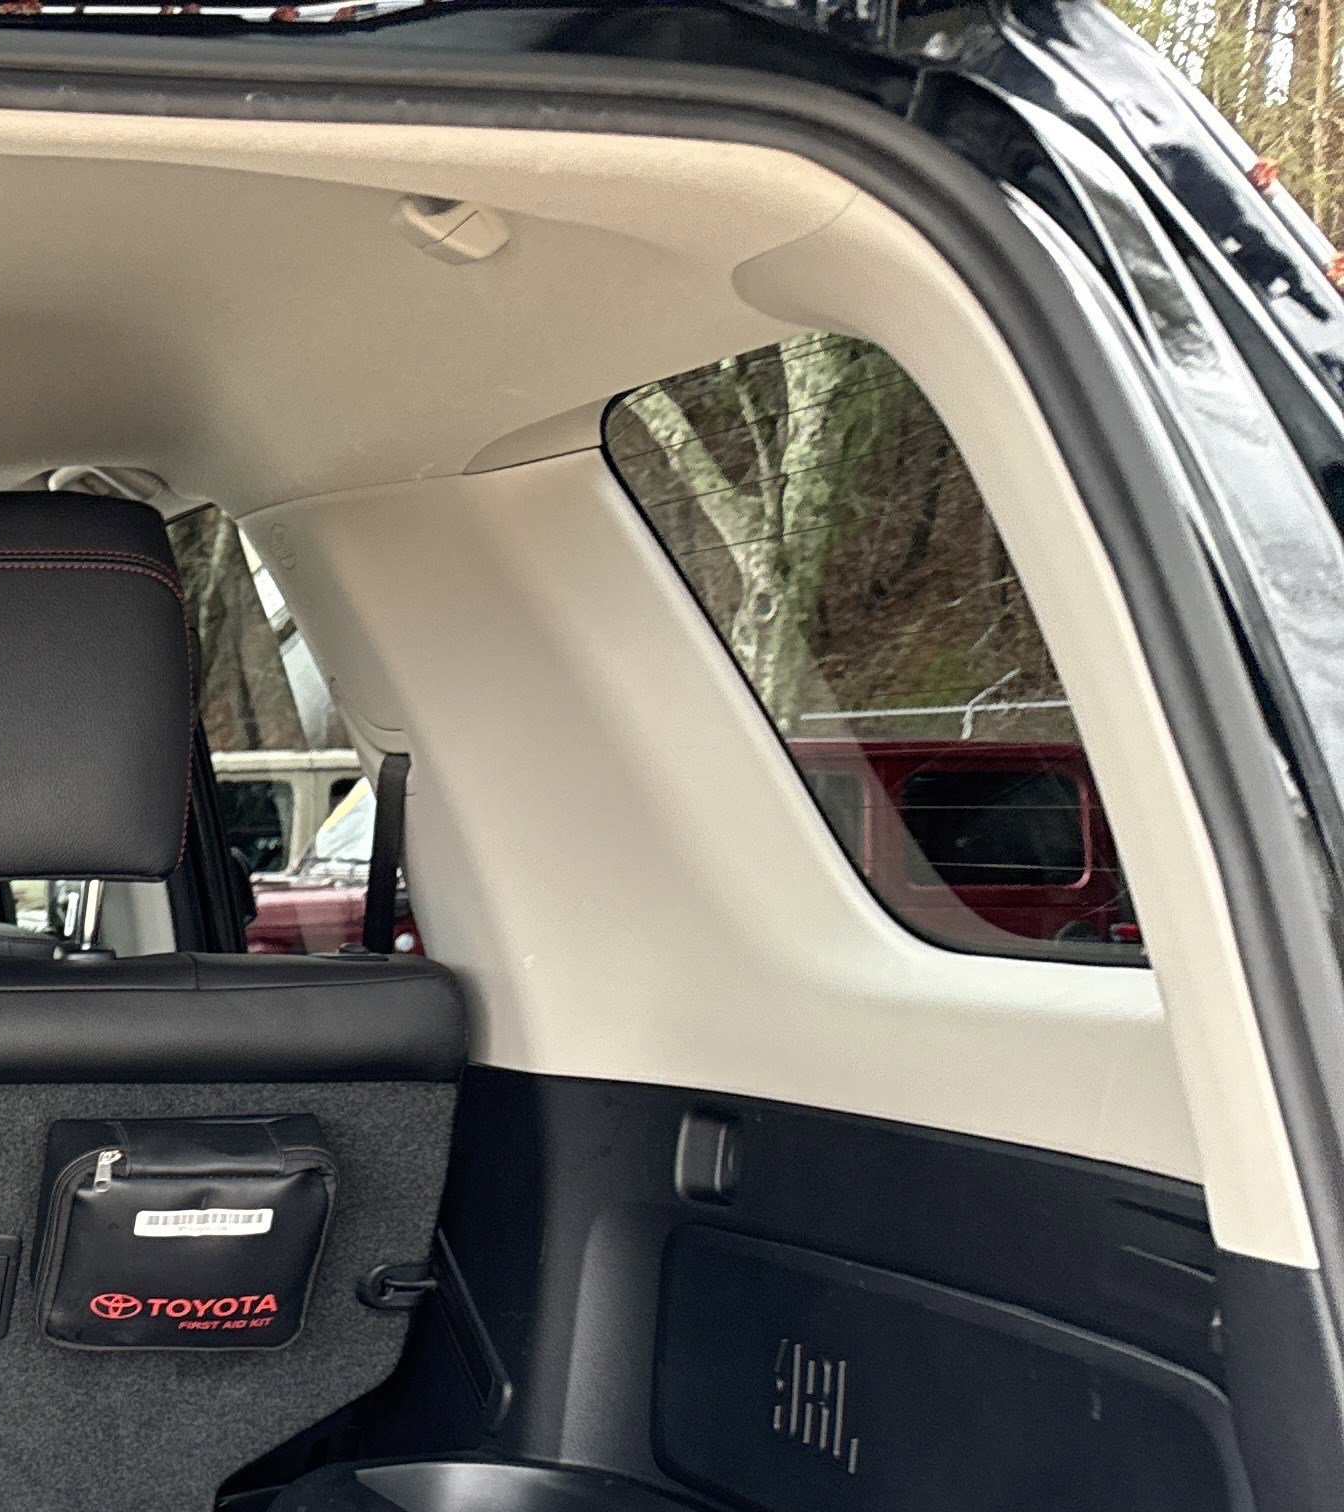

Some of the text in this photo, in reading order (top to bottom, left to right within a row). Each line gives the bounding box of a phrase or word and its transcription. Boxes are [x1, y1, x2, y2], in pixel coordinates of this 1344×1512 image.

[147, 1293, 278, 1318] TOYOTA
[177, 1317, 274, 1330] FIRST AID KIT
